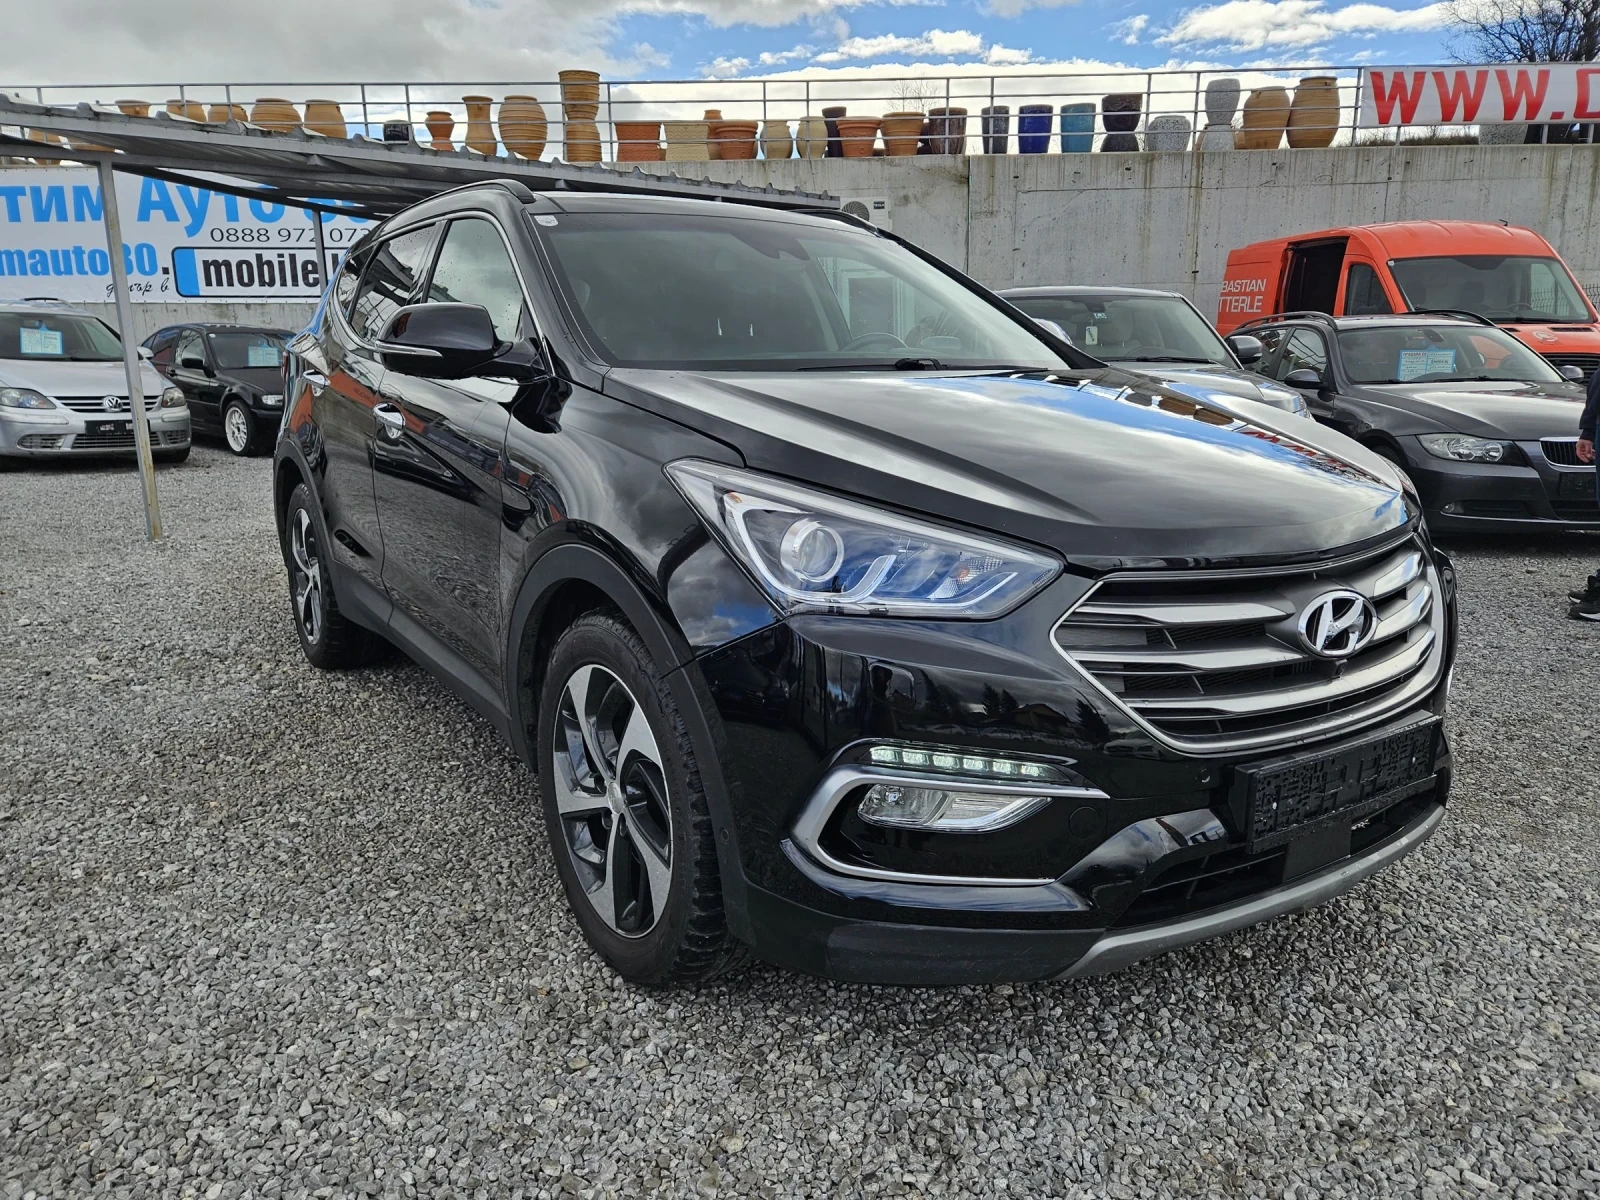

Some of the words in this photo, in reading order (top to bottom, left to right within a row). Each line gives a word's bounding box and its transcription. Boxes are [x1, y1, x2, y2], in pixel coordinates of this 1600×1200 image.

[210, 227, 271, 243] 0888
[277, 227, 315, 243] 972
[202, 252, 339, 288] mobile
[1221, 278, 1267, 293] BASTIAN
[1218, 295, 1264, 313] TTERLE
